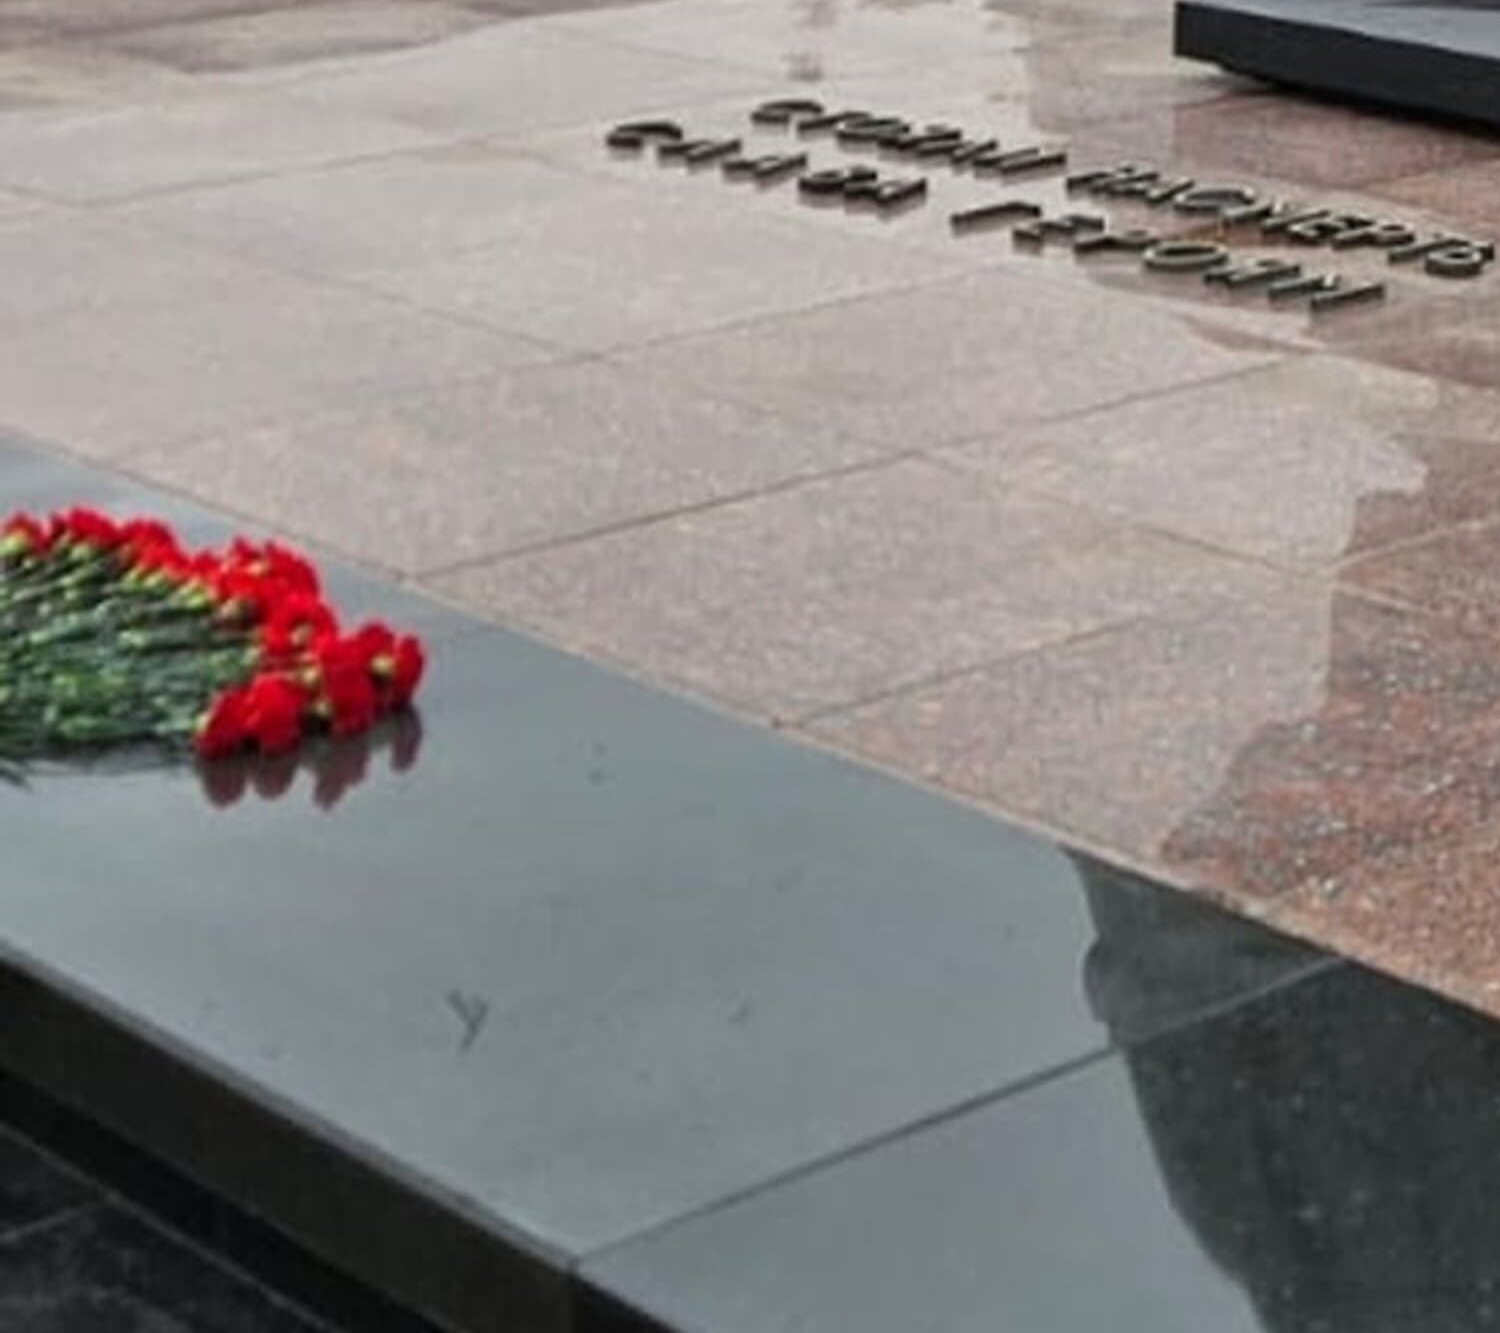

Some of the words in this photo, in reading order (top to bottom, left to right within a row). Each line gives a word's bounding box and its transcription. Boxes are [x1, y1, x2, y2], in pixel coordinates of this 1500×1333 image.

[607, 121, 926, 205] СЛАВА
[950, 201, 1385, 310] ГЕРОЯМ
[751, 100, 1066, 175] СТОЯЛИ
[1067, 165, 1495, 277] НАСМЕРТЬ
